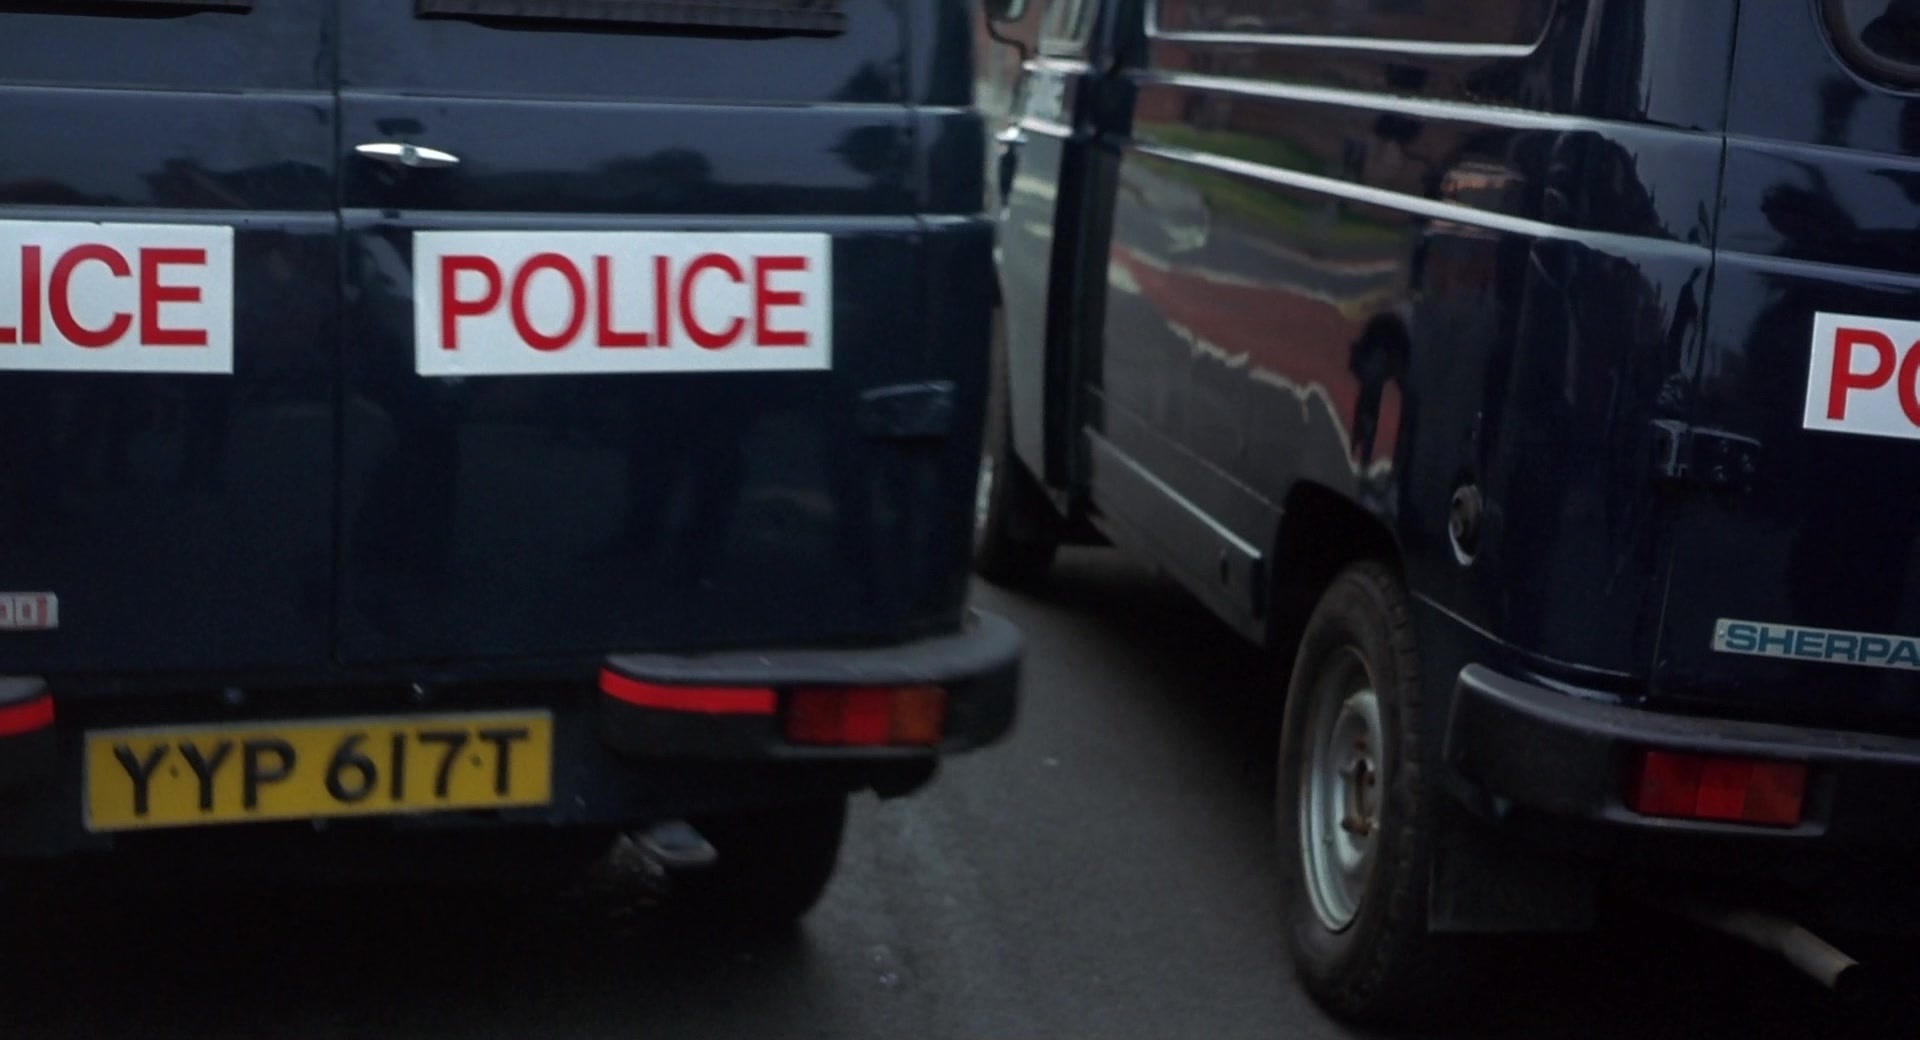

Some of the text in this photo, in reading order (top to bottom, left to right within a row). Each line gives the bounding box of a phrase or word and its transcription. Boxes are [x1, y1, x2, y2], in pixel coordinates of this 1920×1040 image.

[438, 252, 811, 352] POLICE
[1724, 622, 1920, 667] SHERPA
[113, 727, 531, 817] YYP 617T
